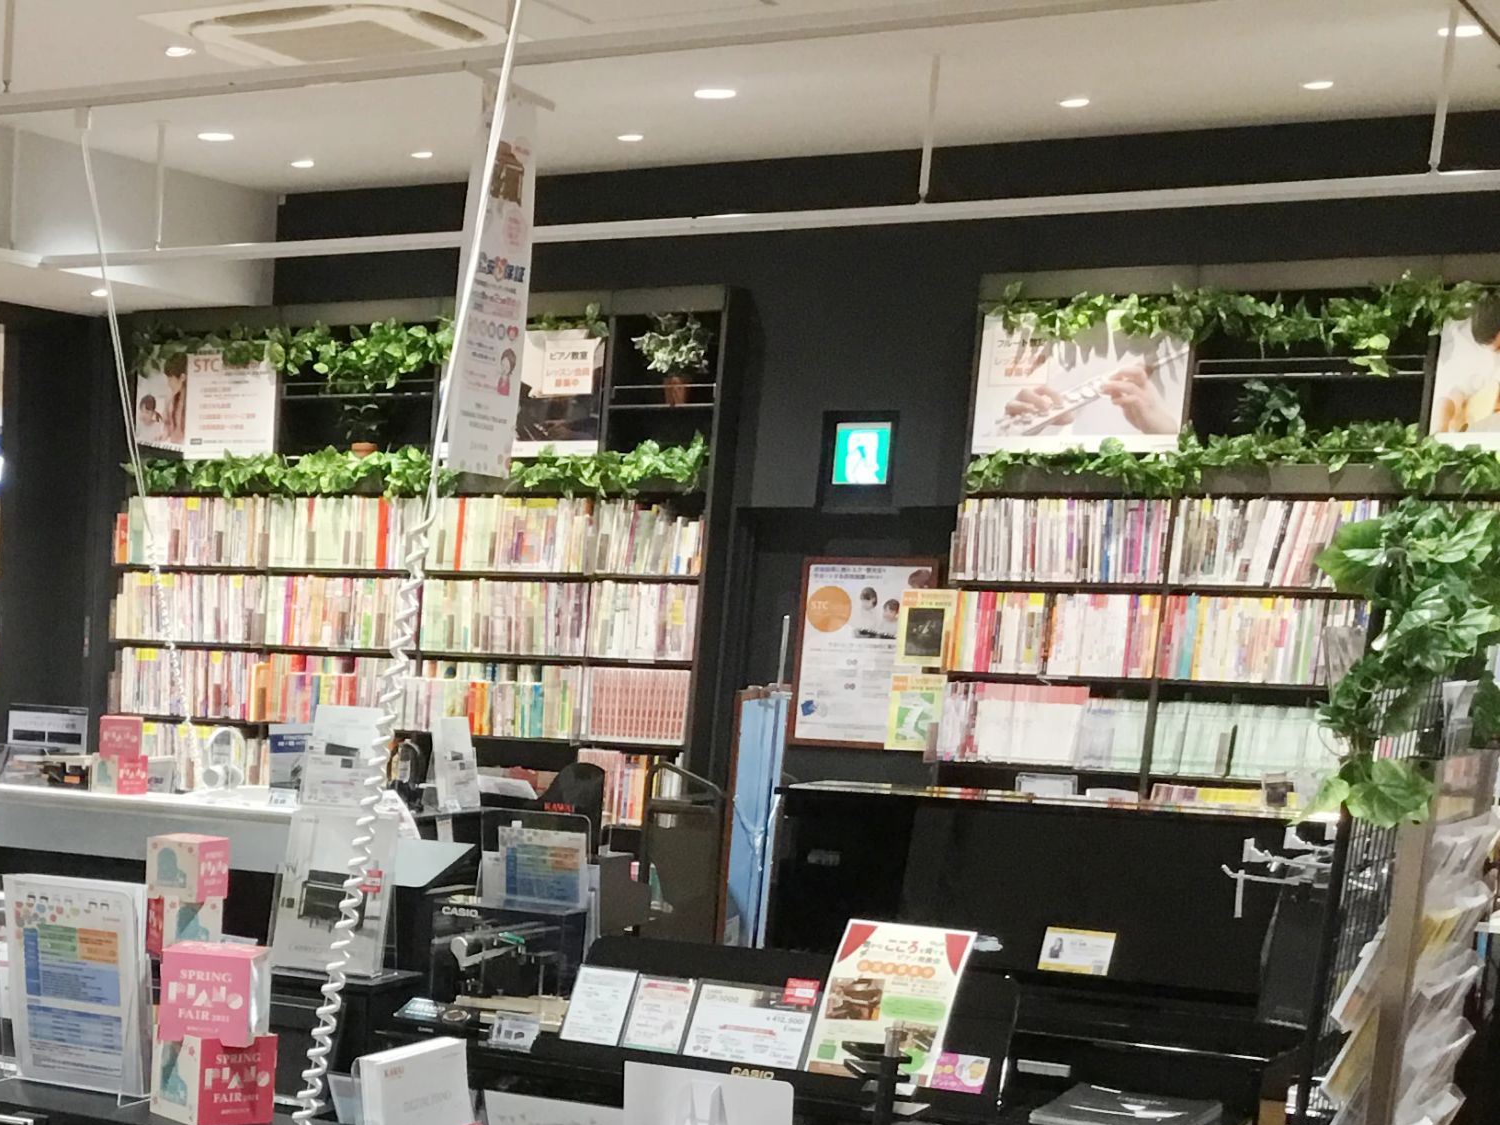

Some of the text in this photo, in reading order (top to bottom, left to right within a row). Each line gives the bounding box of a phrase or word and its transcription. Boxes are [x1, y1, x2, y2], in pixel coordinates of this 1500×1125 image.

[194, 358, 220, 373] STC
[442, 906, 479, 918] CASIO
[180, 969, 232, 983] SPRING
[168, 981, 243, 1010] PIANO
[178, 1008, 210, 1022] FAIR
[216, 1052, 261, 1065] SPRING
[204, 1066, 270, 1090] PIANO
[731, 1066, 775, 1080] CASIO
[213, 1092, 242, 1103] FAIR
